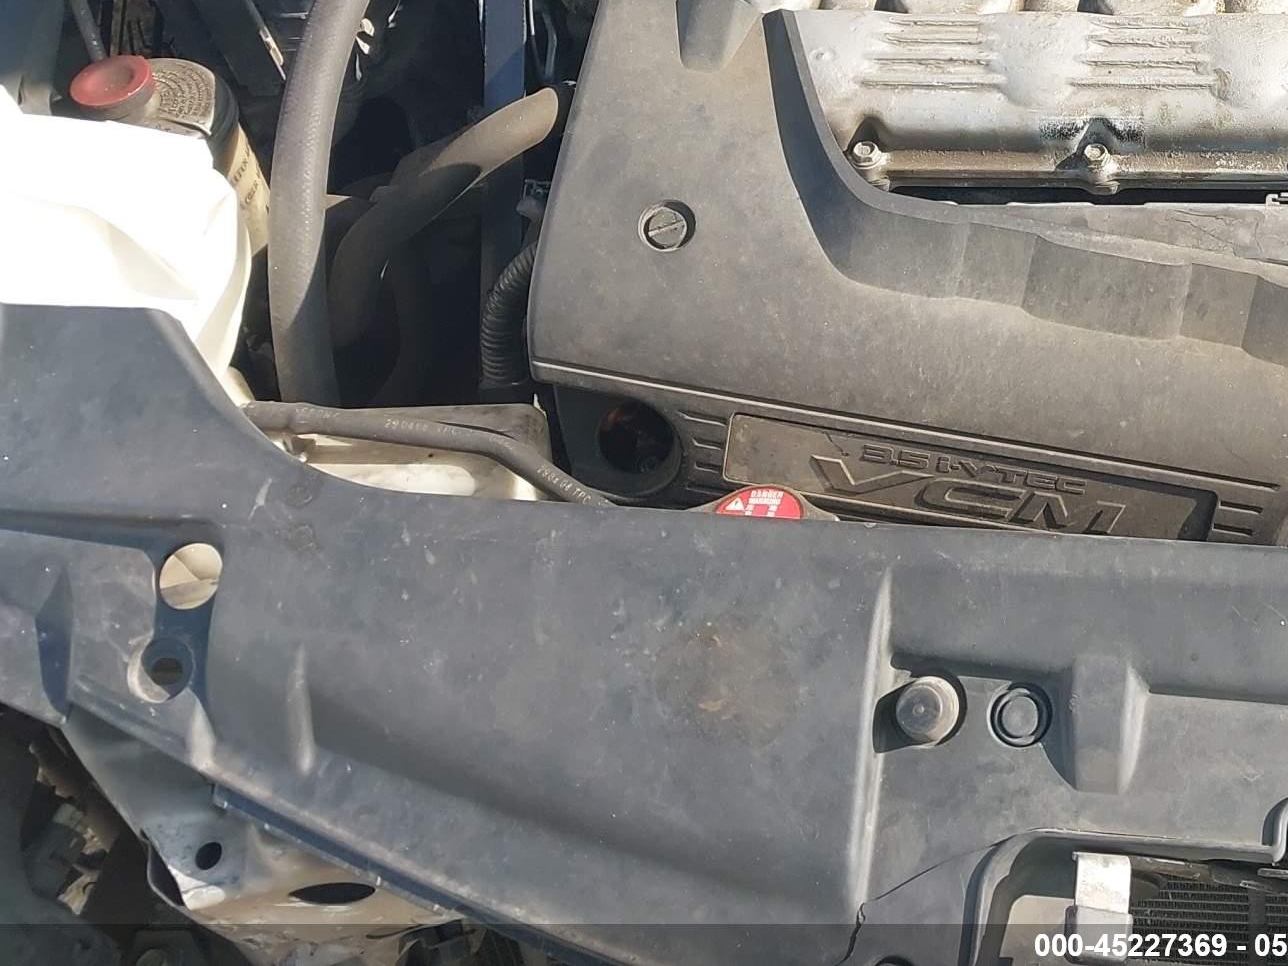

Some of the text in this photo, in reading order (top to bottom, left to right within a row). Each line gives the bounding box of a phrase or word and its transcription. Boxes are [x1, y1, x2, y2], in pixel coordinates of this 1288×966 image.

[751, 490, 785, 499] DANGER
[810, 454, 1127, 534] VCM
[860, 443, 1088, 495] 3.5 i-VTEC
